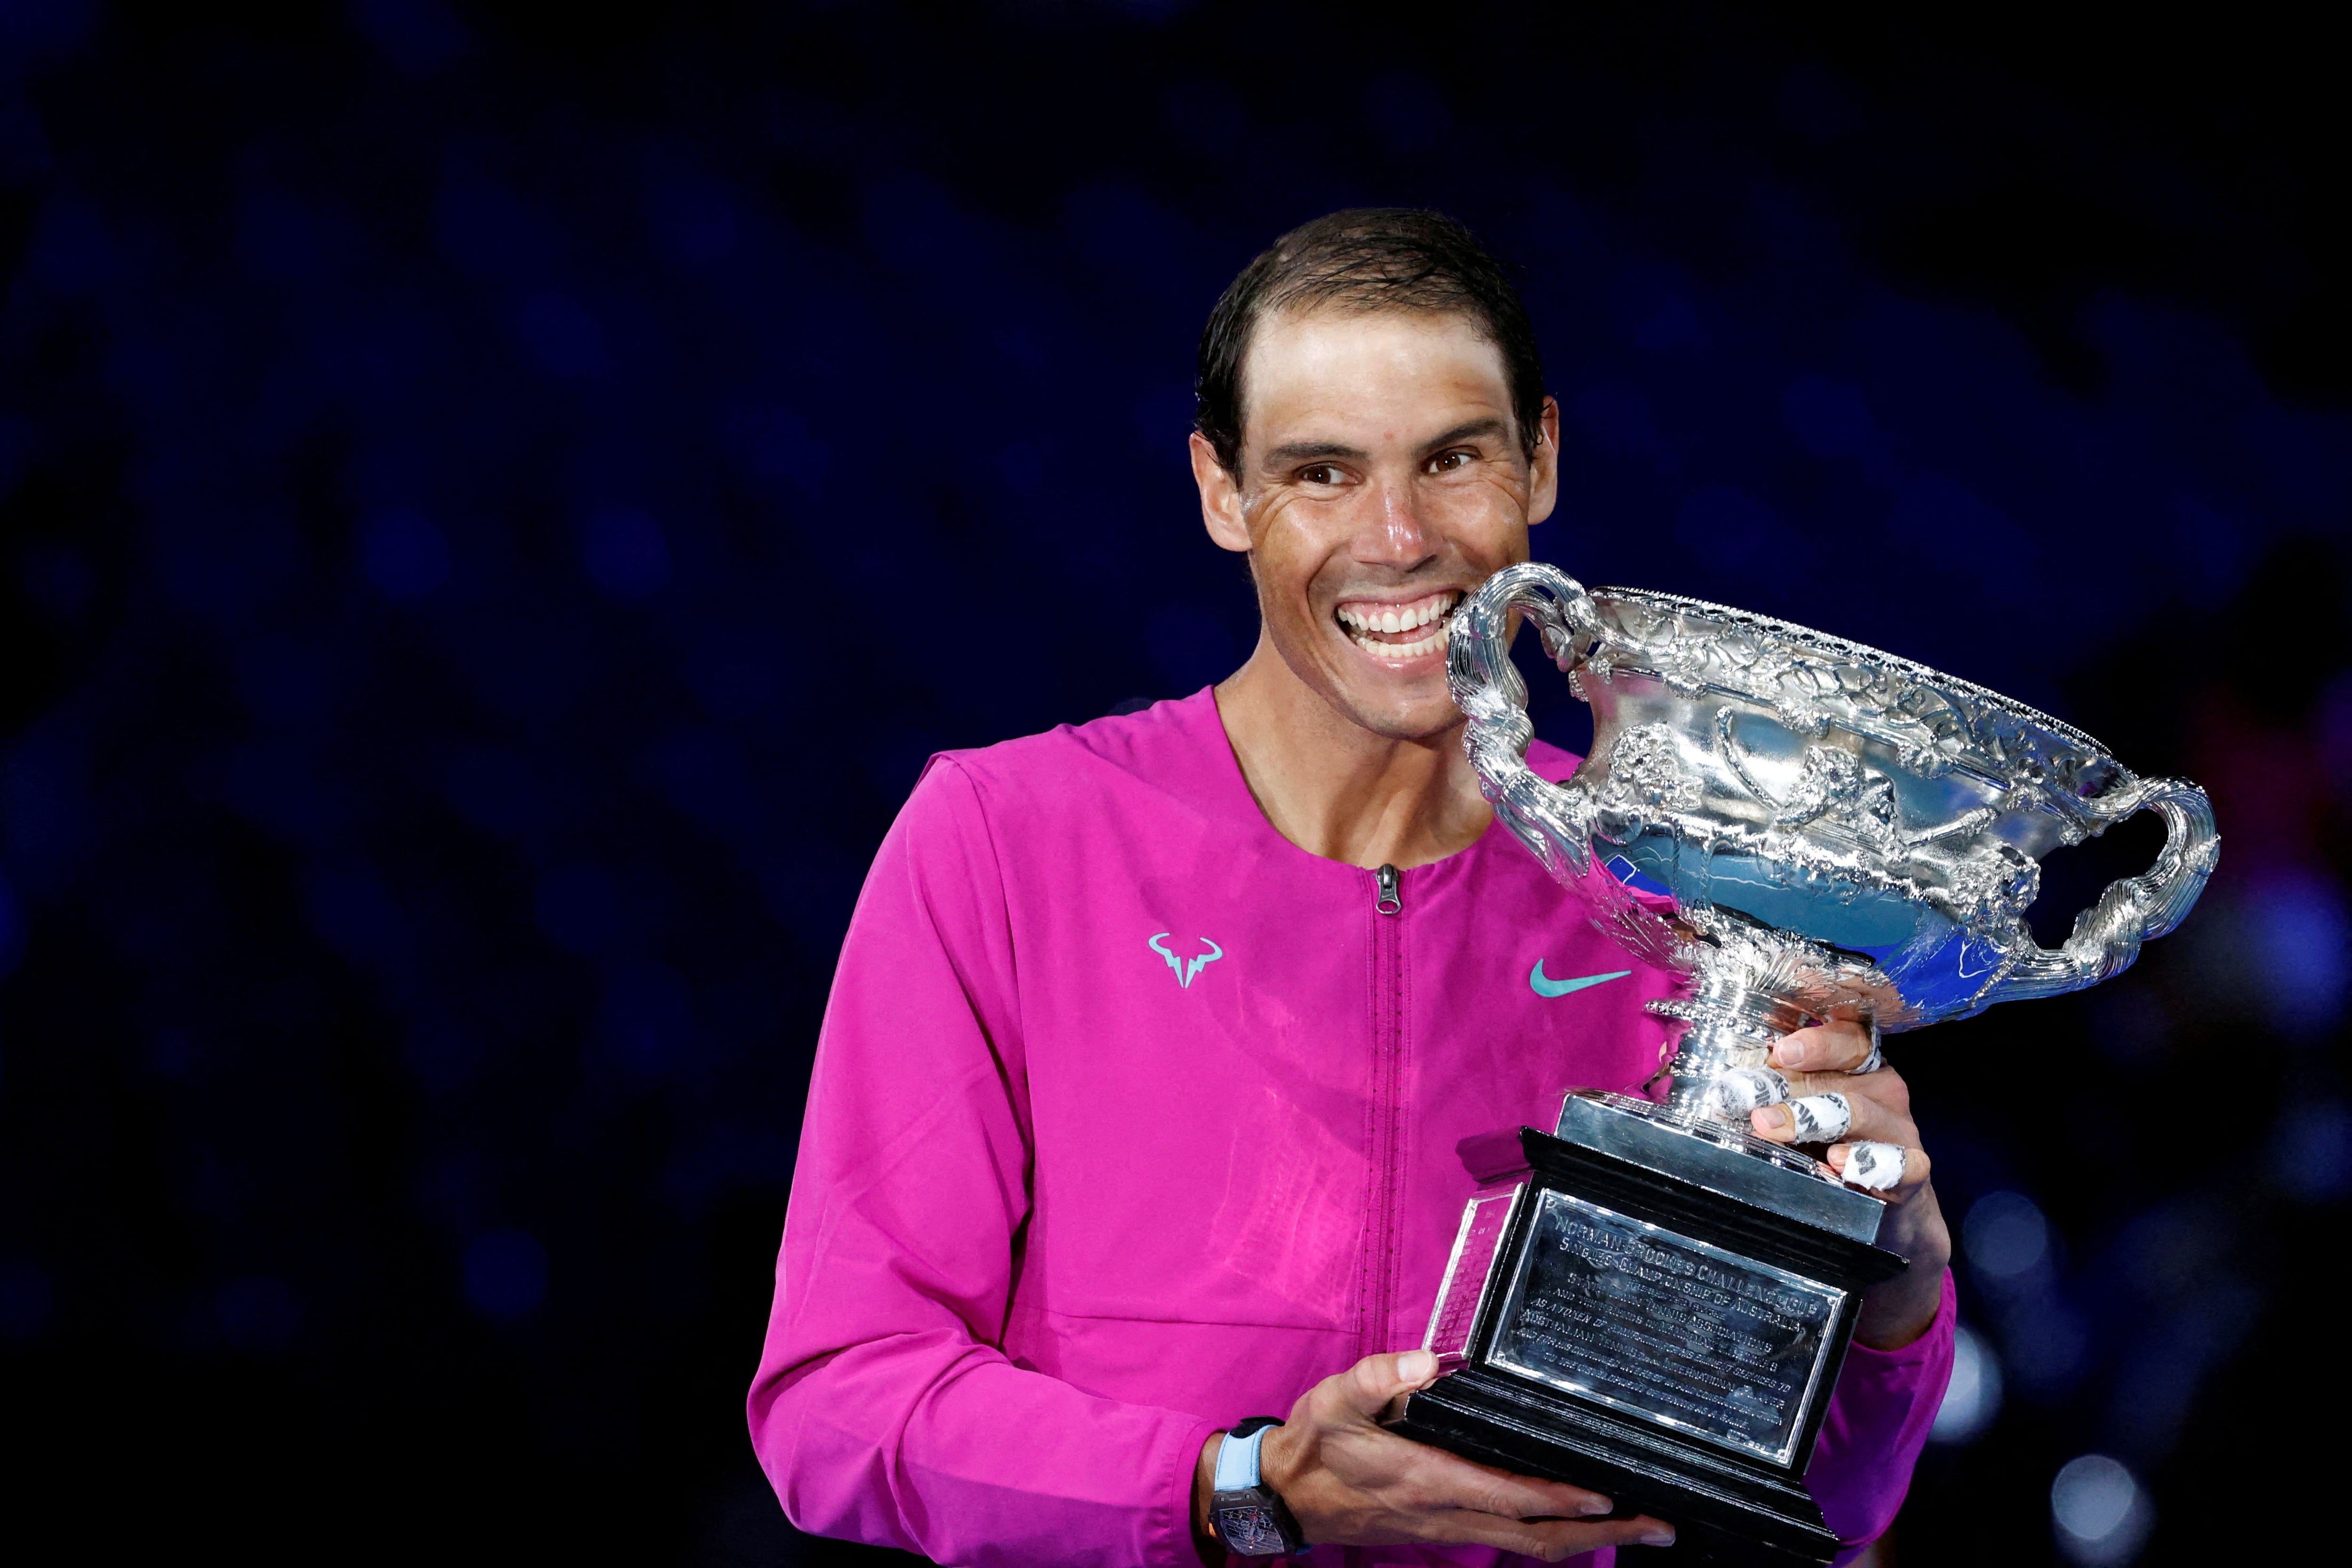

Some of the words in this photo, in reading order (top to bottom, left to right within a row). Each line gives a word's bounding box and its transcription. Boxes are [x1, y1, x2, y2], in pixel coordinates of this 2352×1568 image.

[1553, 1215, 1622, 1251] NORMAN
[1552, 1286, 1576, 1301] AND
[1713, 1292, 1731, 1307] OF
[1519, 1307, 1596, 1343] AUSTRALIAN
[1645, 1300, 1688, 1324] TENNIS
[1530, 1295, 1548, 1309] AS
[1546, 1301, 1557, 1312] A
[1557, 1305, 1593, 1324] TOKEN
[1778, 1381, 1792, 1394] TO
